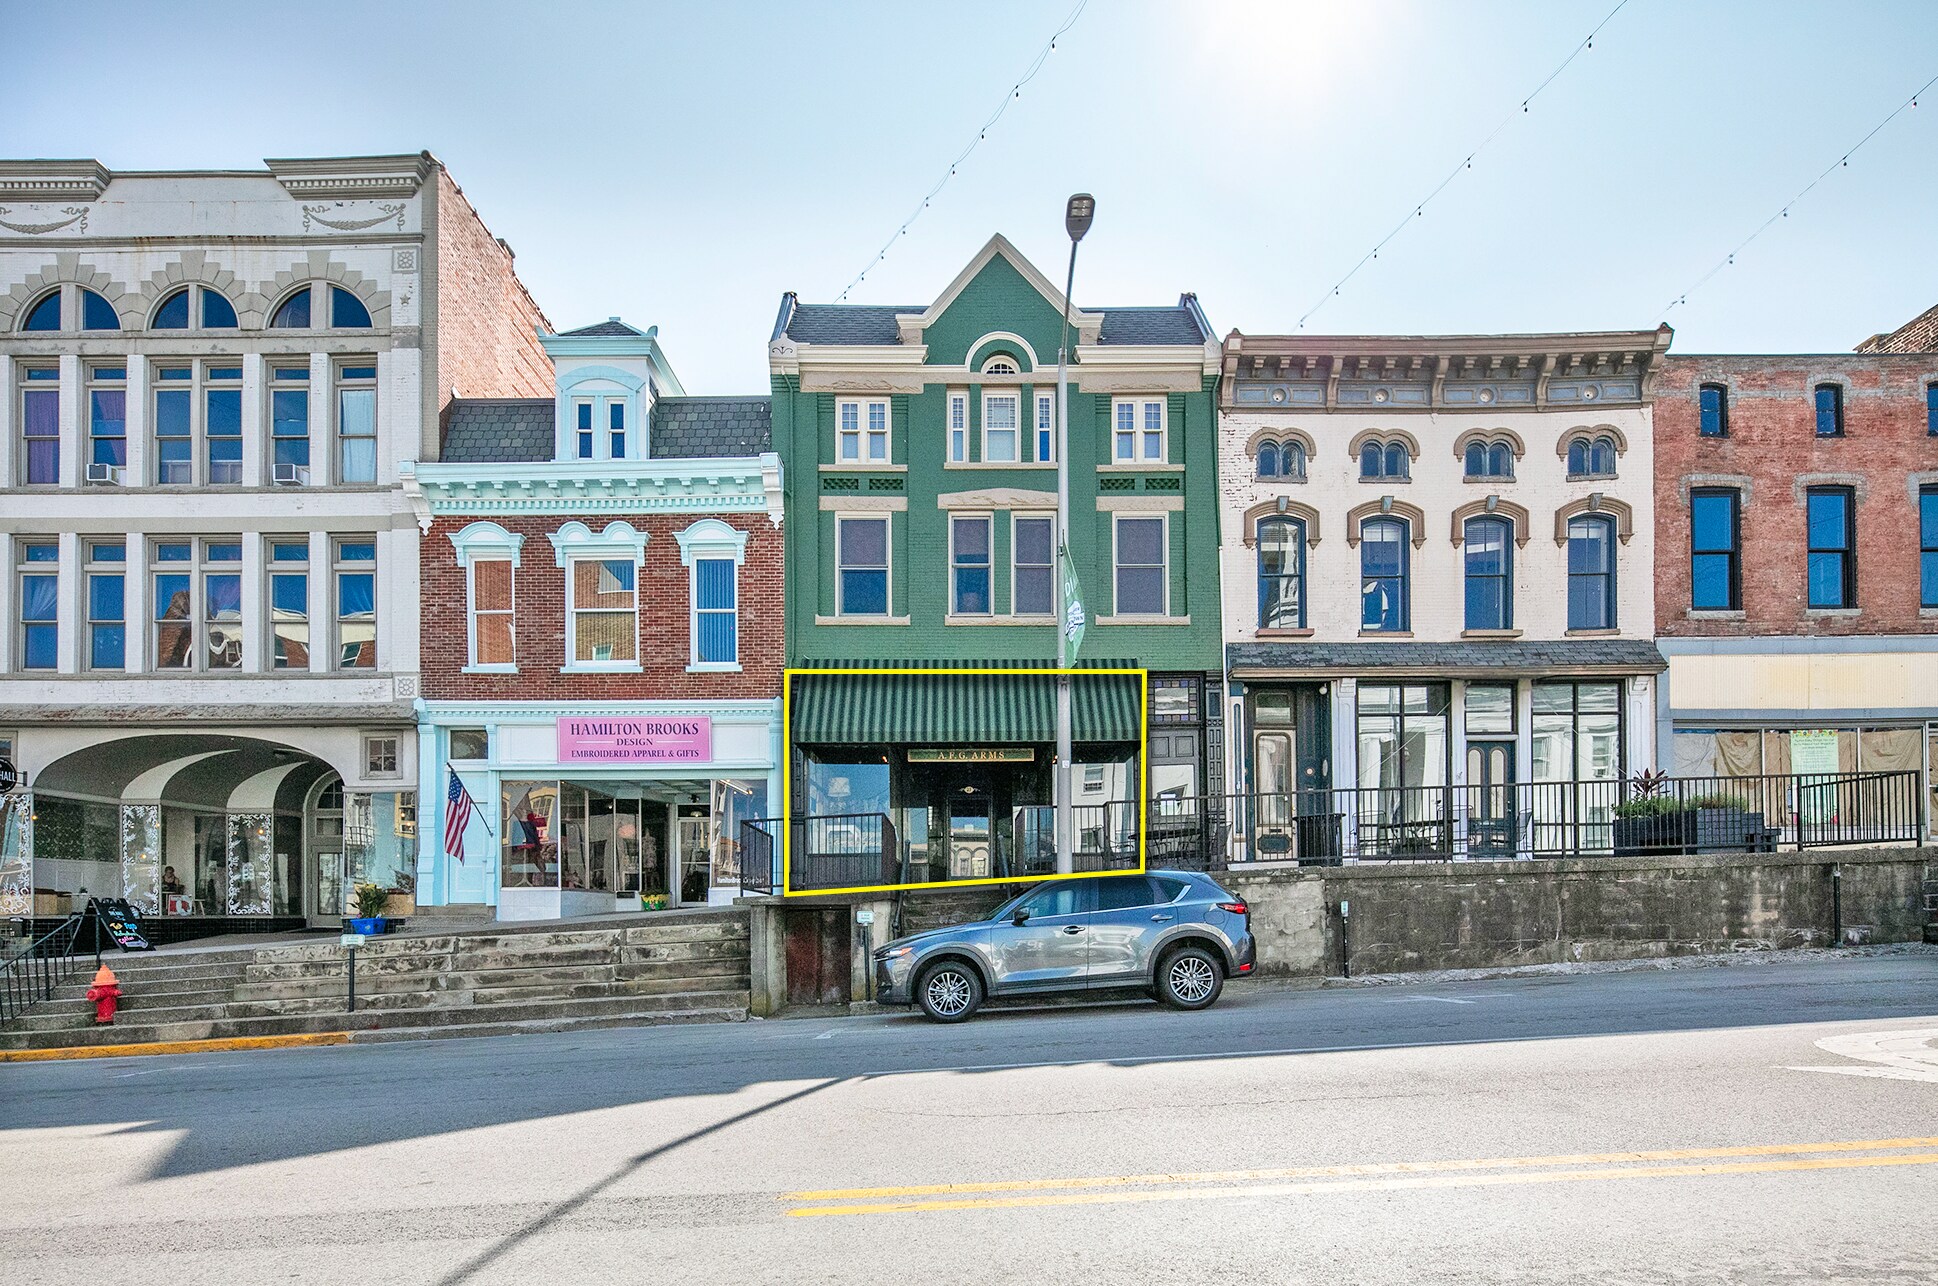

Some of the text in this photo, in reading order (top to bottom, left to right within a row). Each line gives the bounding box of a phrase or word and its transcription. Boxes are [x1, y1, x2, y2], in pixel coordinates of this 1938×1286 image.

[571, 723, 699, 735] HAMILTON BROOKS
[616, 738, 653, 746] DESIGN
[571, 750, 699, 758] EMBROIDERED APPAREL & GIFTS
[971, 752, 1005, 760] ARMS
